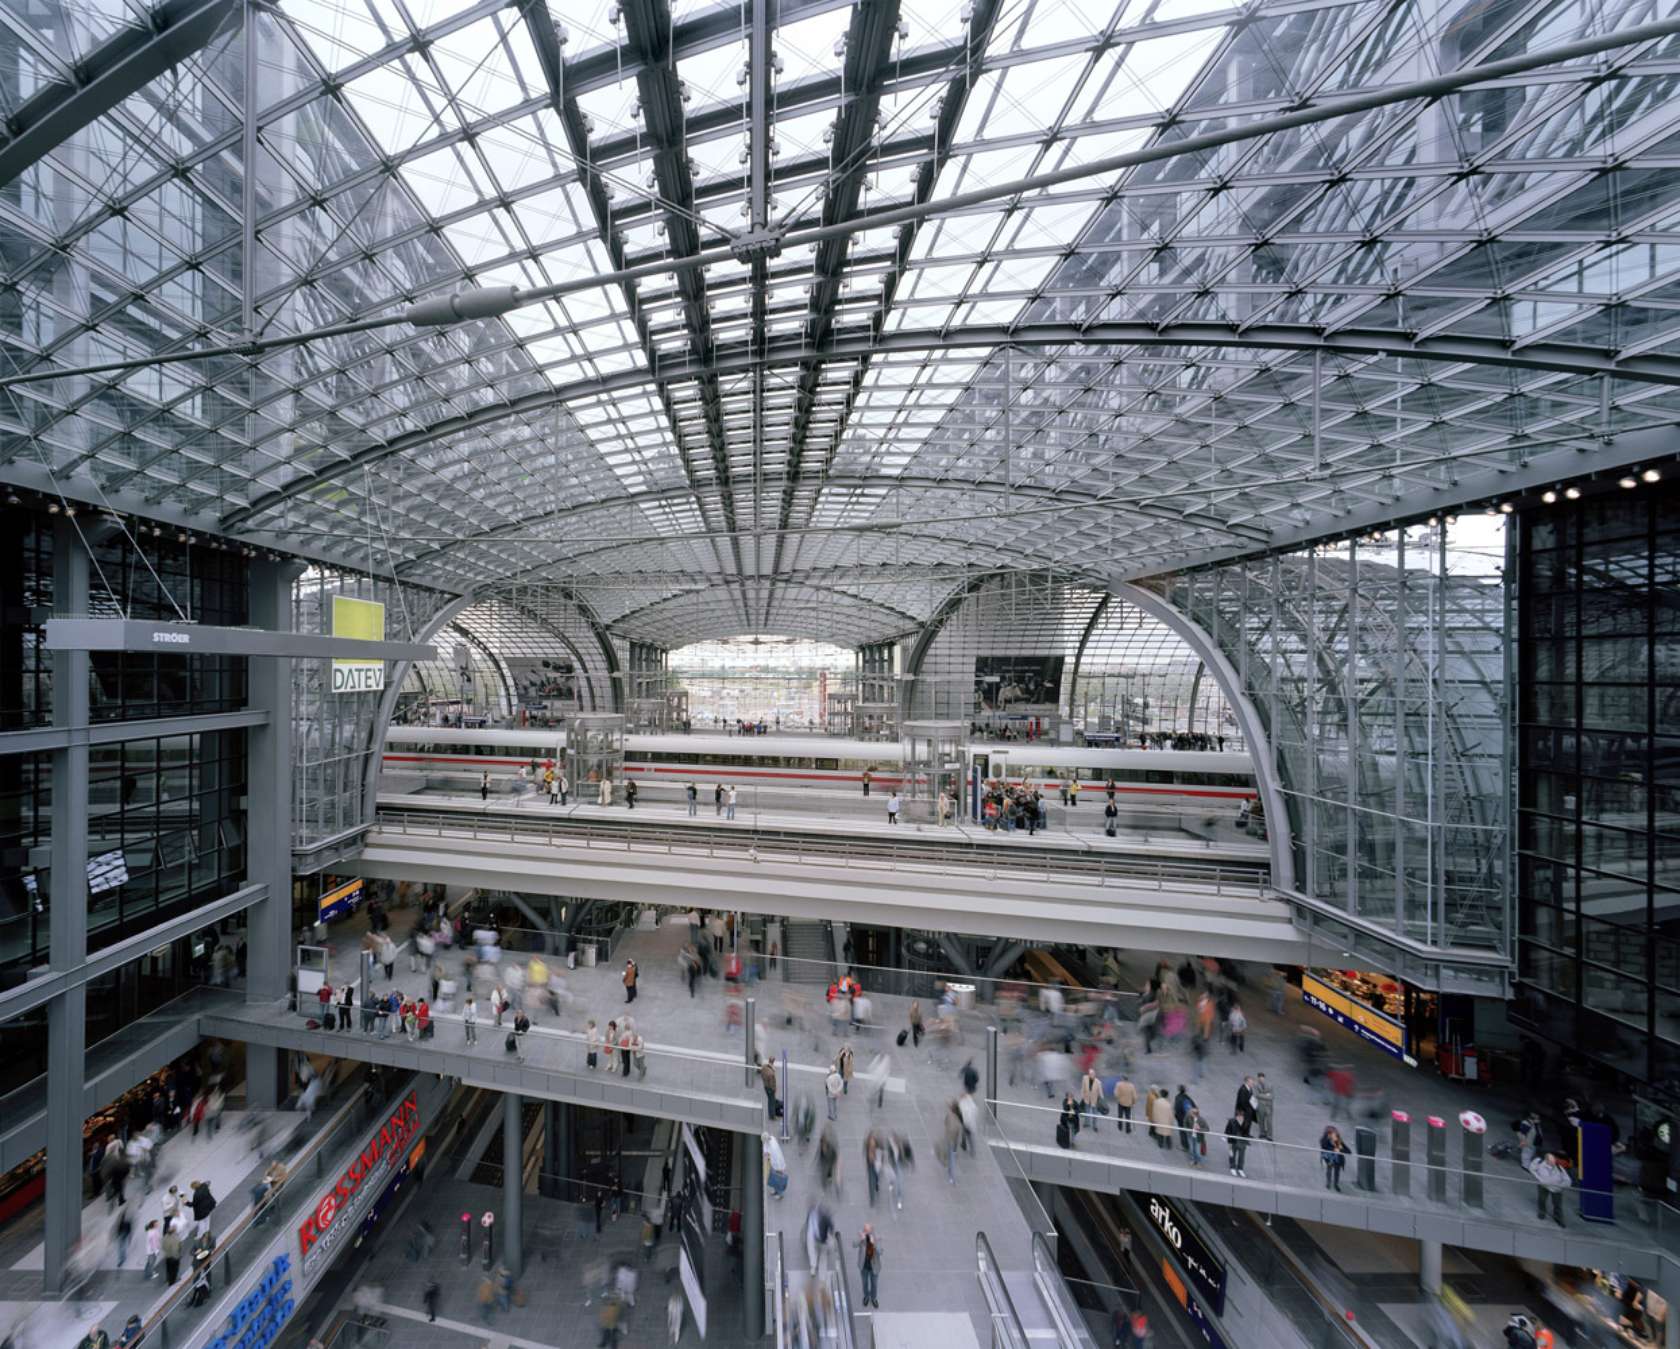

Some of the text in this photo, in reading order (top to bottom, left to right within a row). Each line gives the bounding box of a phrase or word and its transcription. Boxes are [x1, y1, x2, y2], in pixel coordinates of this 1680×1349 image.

[333, 668, 383, 690] DATEV
[299, 1091, 418, 1256] ROSSMANN
[1150, 1198, 1182, 1249] arko
